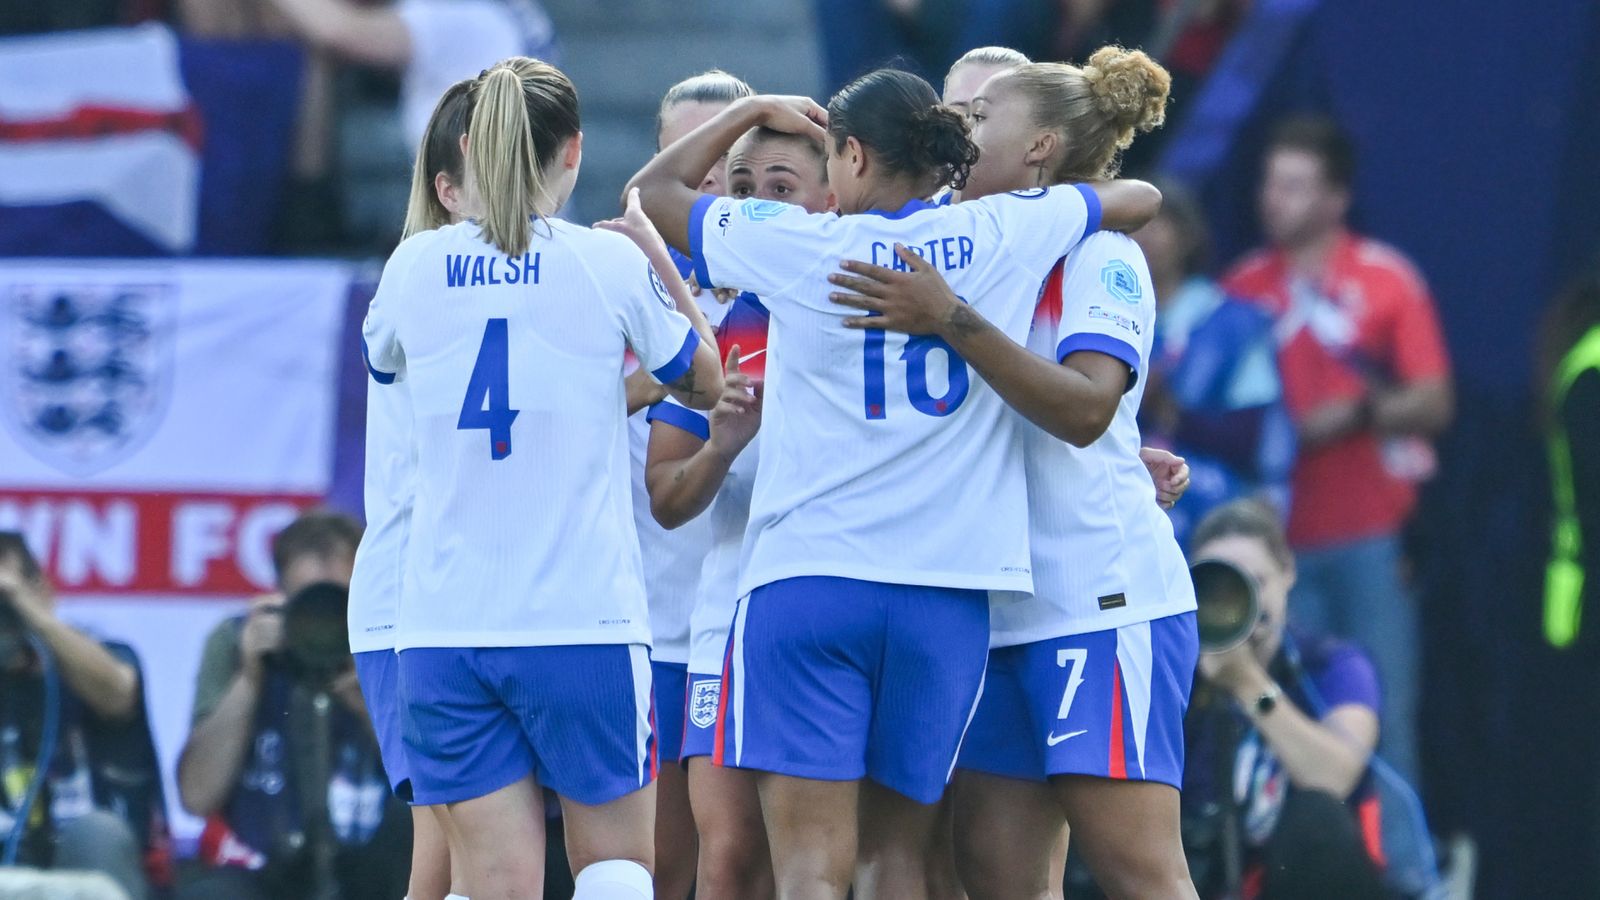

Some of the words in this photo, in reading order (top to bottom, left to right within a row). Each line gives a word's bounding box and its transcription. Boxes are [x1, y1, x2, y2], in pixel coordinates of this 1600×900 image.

[446, 252, 541, 287] WALSH
[457, 318, 520, 460] 4
[863, 296, 969, 420] 16
[1057, 648, 1087, 719] 7
